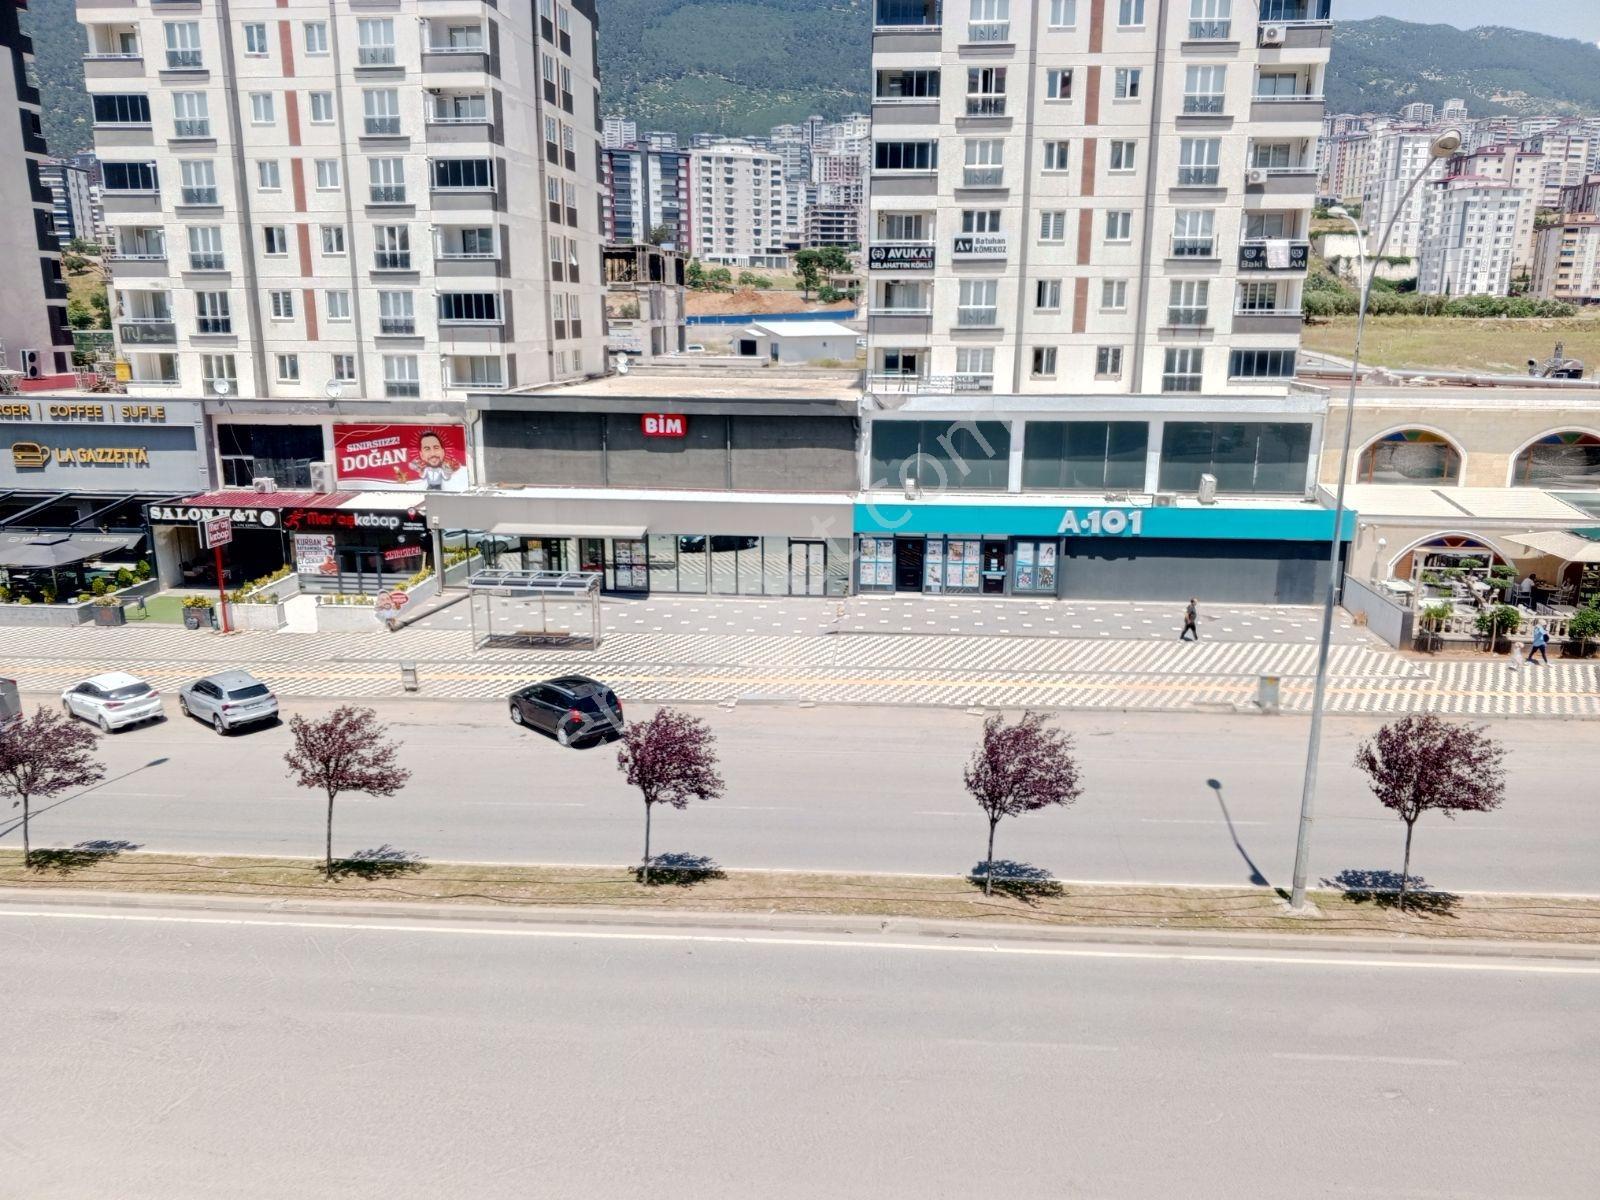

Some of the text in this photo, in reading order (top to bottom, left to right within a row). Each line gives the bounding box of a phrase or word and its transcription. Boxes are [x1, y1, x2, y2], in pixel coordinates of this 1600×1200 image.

[956, 240, 971, 251] Av
[975, 237, 1006, 245] Batuhan
[888, 248, 934, 259] AVUKAT
[1241, 260, 1263, 268] Baki
[50, 405, 103, 417] COFFEE
[121, 405, 165, 419] SUFLE
[645, 414, 683, 434] BİM
[55, 447, 74, 463] LA
[341, 448, 408, 472] DOĞAN
[149, 506, 215, 521] SALON
